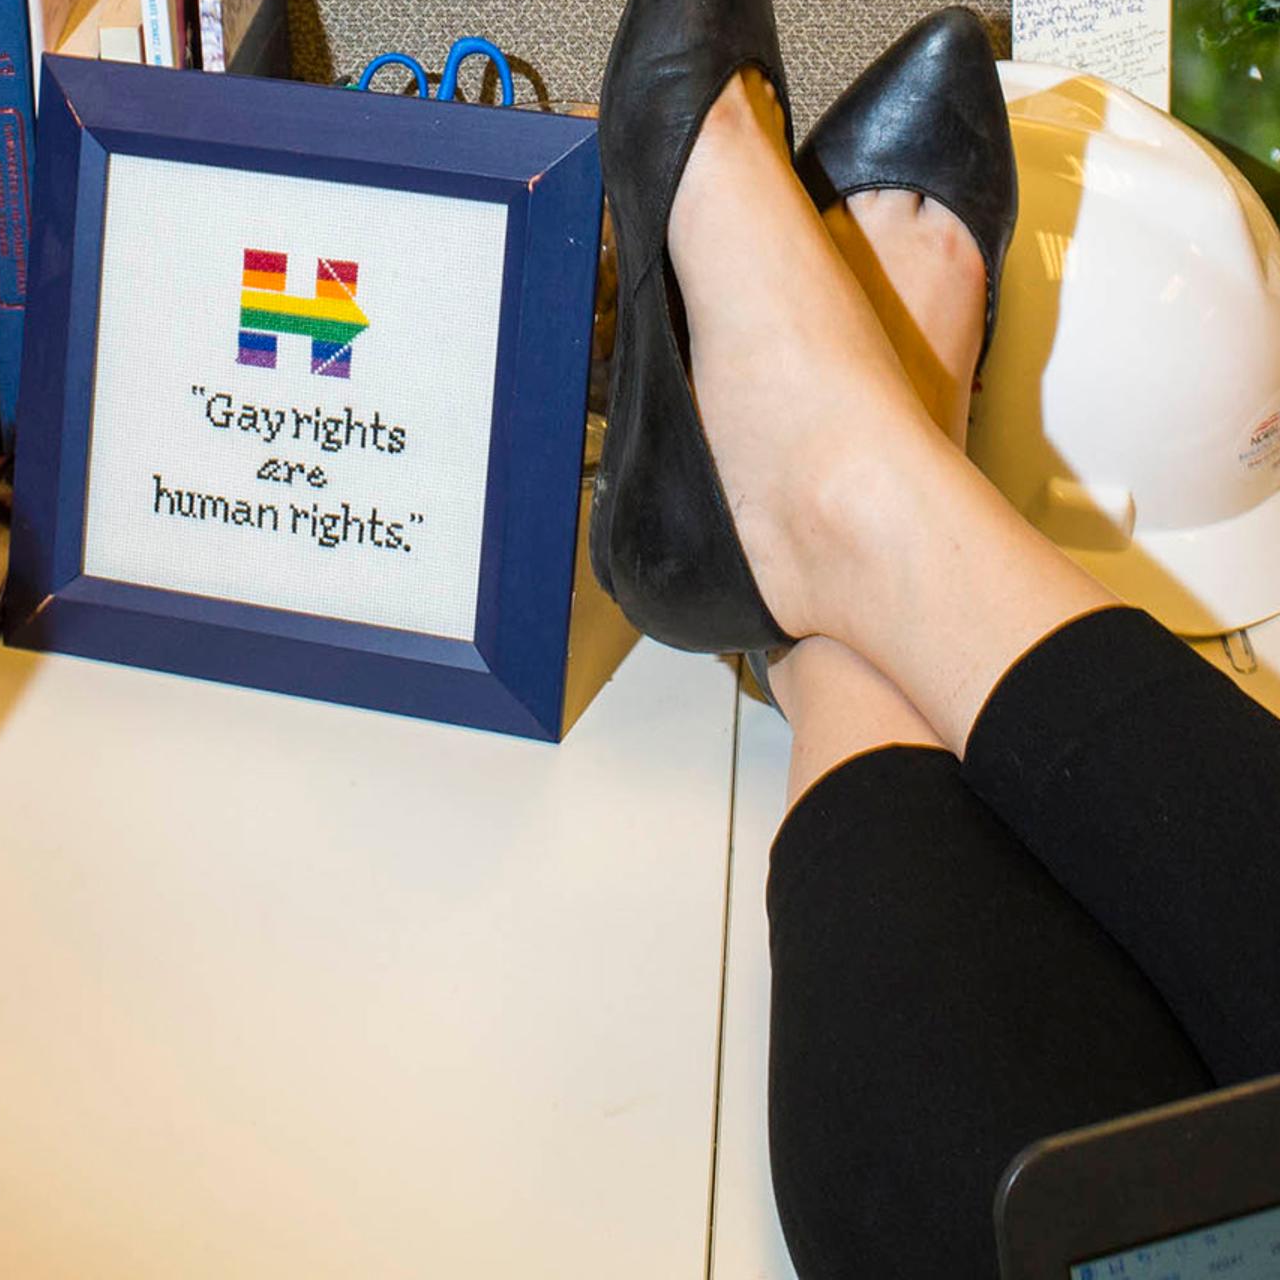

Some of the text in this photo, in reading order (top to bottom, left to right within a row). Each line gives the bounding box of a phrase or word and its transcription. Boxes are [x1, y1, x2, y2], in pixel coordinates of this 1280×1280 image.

[291, 406, 406, 453] rights
[257, 458, 328, 488] are
[153, 474, 279, 531] human
